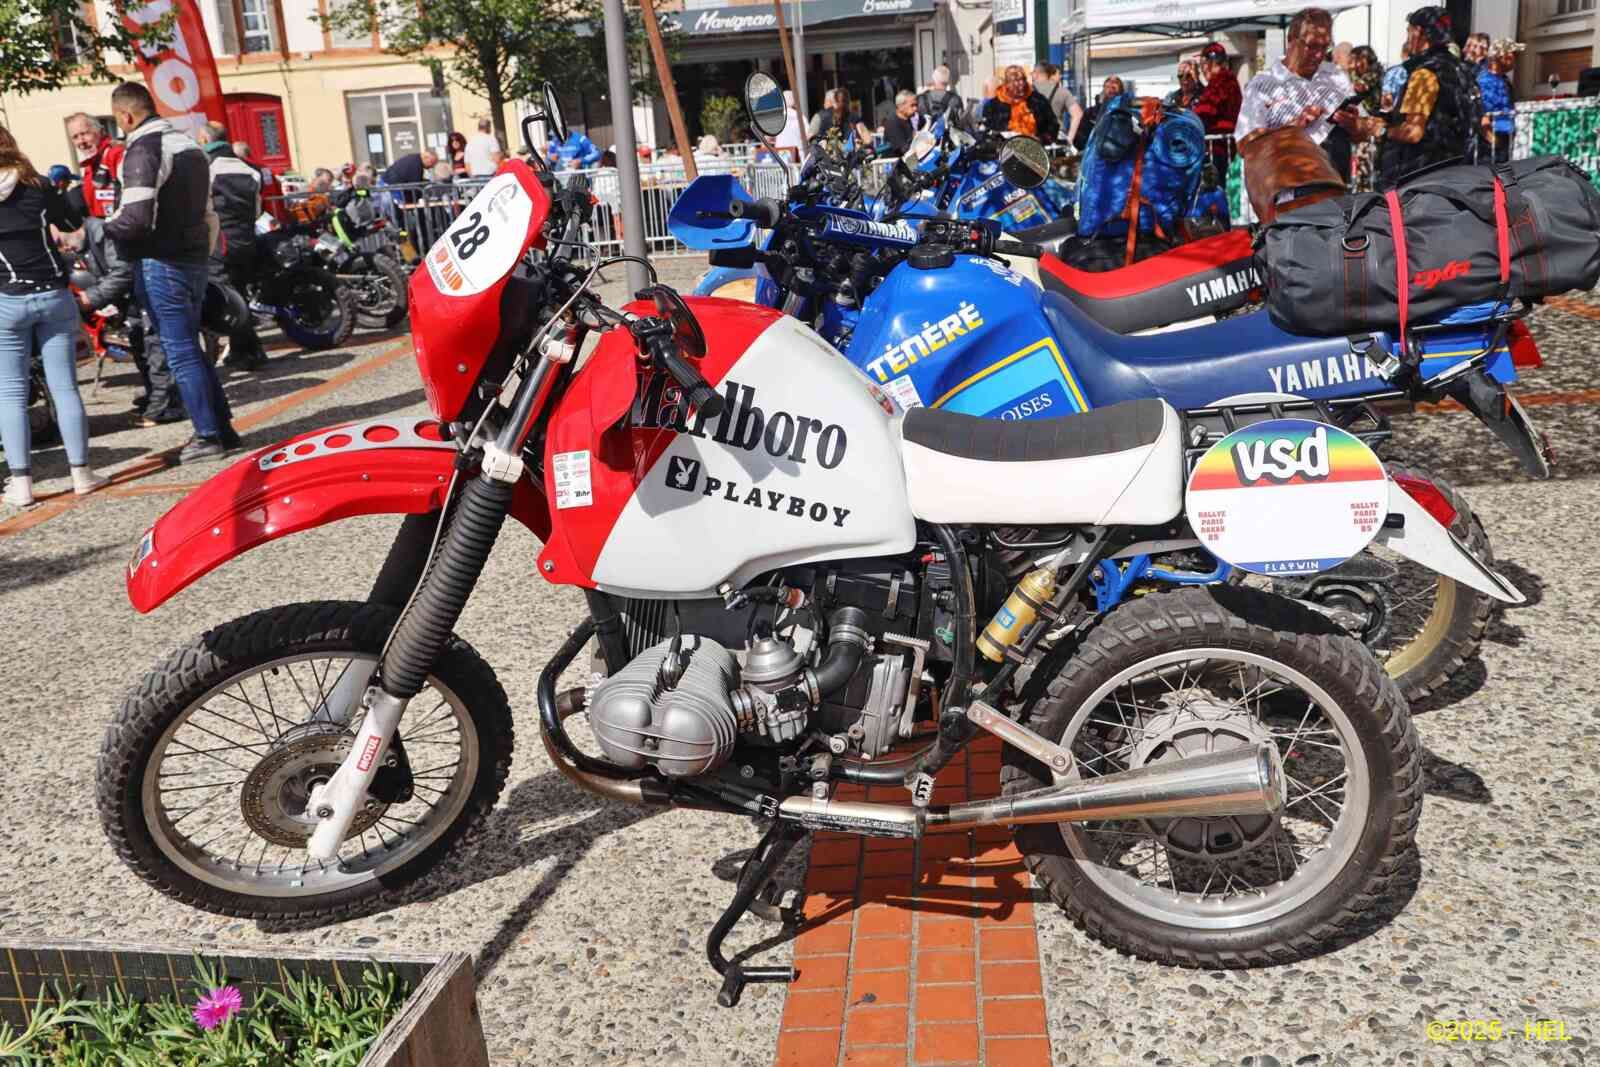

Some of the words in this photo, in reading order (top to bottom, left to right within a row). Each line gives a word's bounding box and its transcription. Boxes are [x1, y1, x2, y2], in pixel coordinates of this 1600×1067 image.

[695, 10, 776, 31] Marignan
[449, 211, 490, 261] 28
[866, 300, 985, 382] TÉNÉRÉ
[702, 476, 851, 527] PLAYBOY
[1350, 502, 1379, 510] RALLYE
[359, 737, 380, 770] MOTUL
